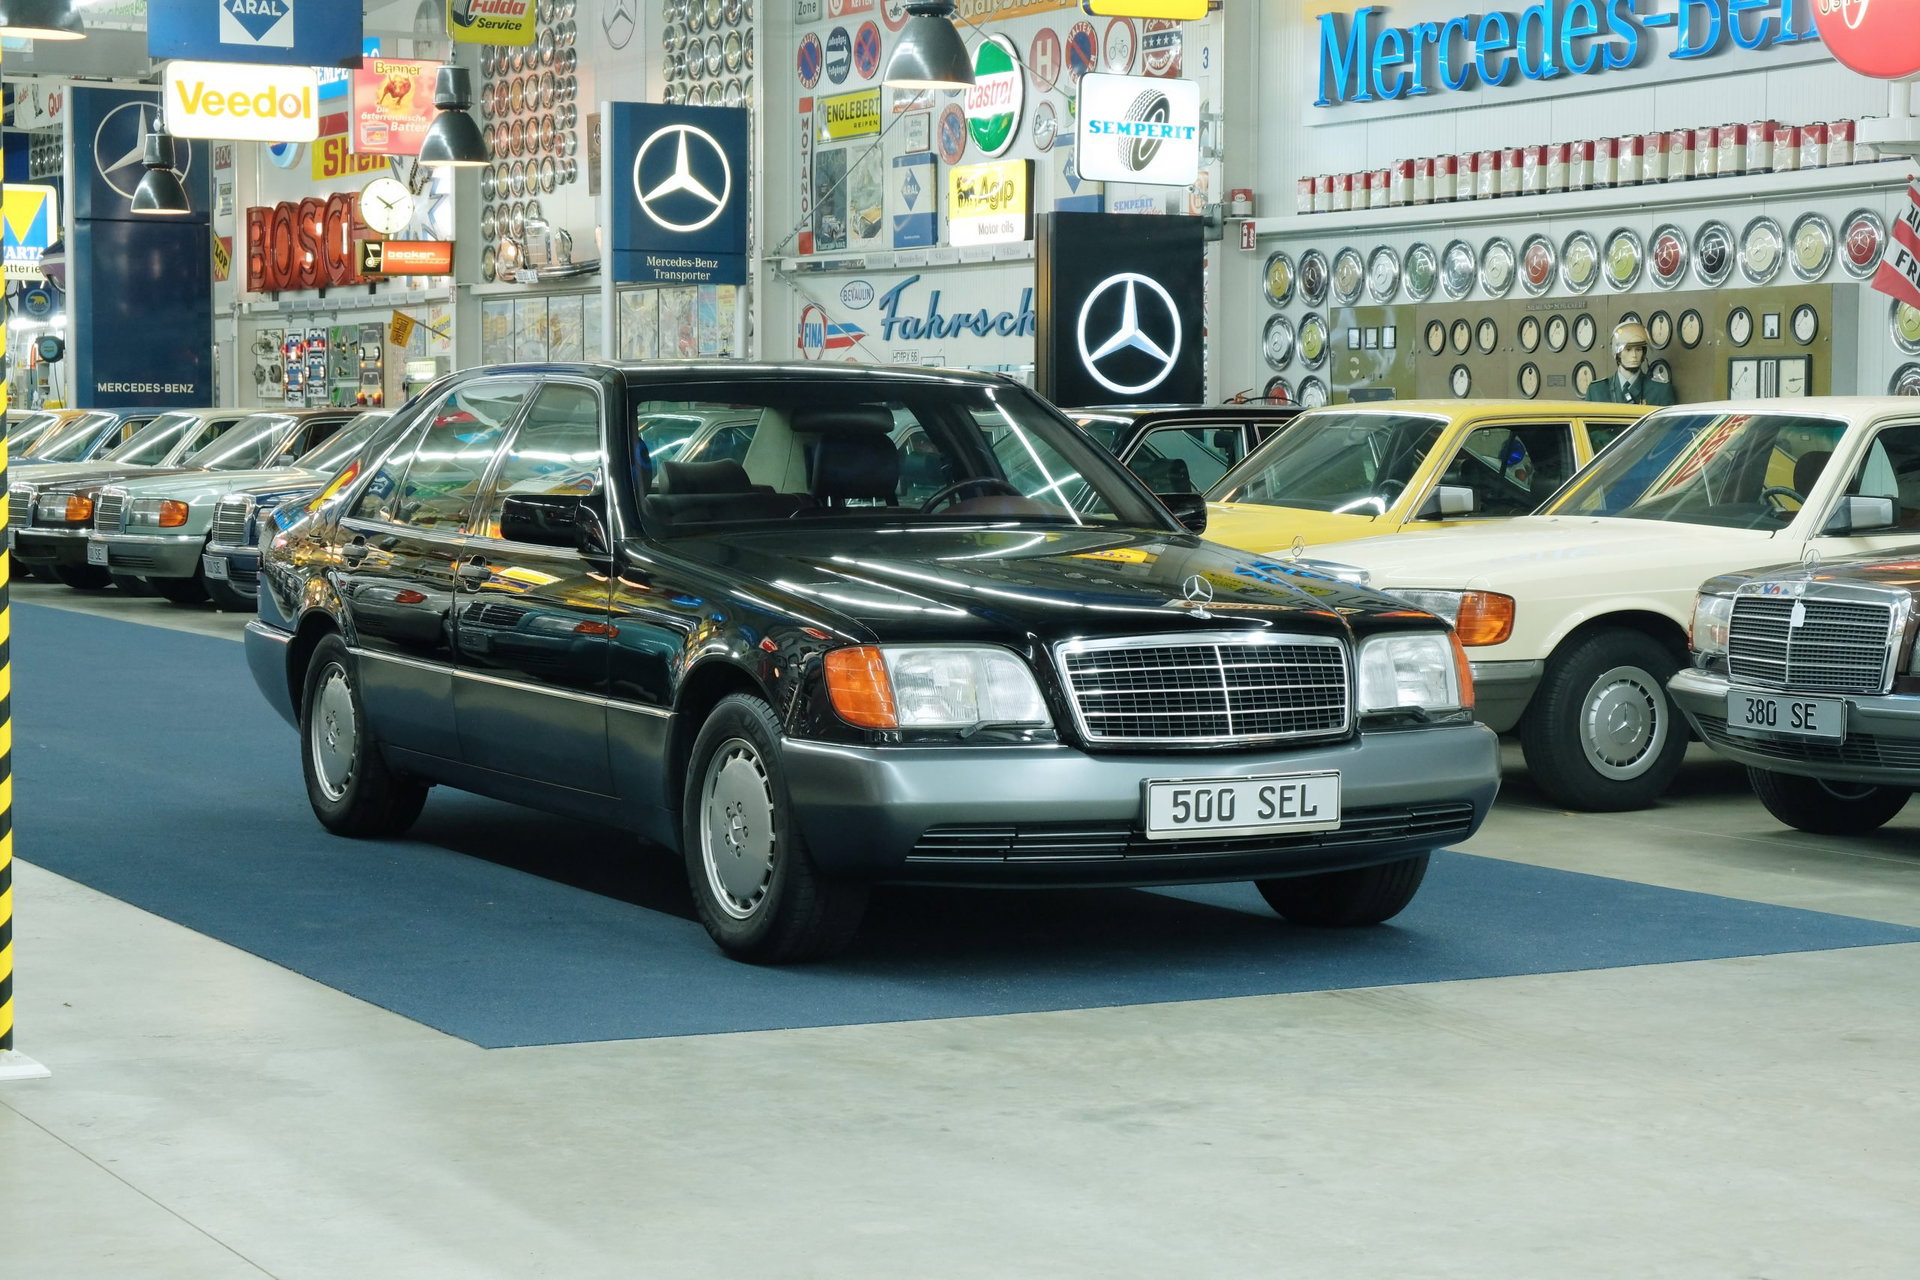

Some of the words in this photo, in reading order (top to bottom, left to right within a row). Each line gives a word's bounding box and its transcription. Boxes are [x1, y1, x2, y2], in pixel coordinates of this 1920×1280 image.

[231, 0, 282, 16] ARAL
[470, 0, 526, 15] Fulda
[798, 2, 817, 16] Zone
[477, 17, 522, 30] Service
[1067, 21, 1093, 43] HALTEN
[1202, 47, 1209, 69] 3
[1313, 0, 1820, 107] Mercedes-Ben
[375, 61, 422, 75] Banner
[175, 80, 311, 119] Veedol
[967, 76, 1015, 111] Castrol
[827, 97, 880, 123] ENGLEBERT
[391, 121, 429, 133] Batter
[1089, 119, 1195, 140] SEMPERIT
[801, 117, 809, 227] MOTANOL
[903, 183, 918, 195] ARAL
[980, 176, 1015, 210] Agip
[978, 222, 999, 235] Motor
[1001, 220, 1014, 233] oils
[1906, 203, 1920, 233] ZI
[4, 263, 41, 274] atterie
[646, 256, 719, 269] Mercedes-Benz
[653, 268, 712, 281] Transporter
[879, 274, 1035, 341] Fahrsch
[804, 324, 823, 348] FINA
[97, 382, 194, 394] MERCEDES-BENZ
[1745, 698, 1777, 726] 380
[1790, 702, 1817, 730] SE
[1172, 788, 1235, 823] 500
[1257, 784, 1317, 819] SEL
